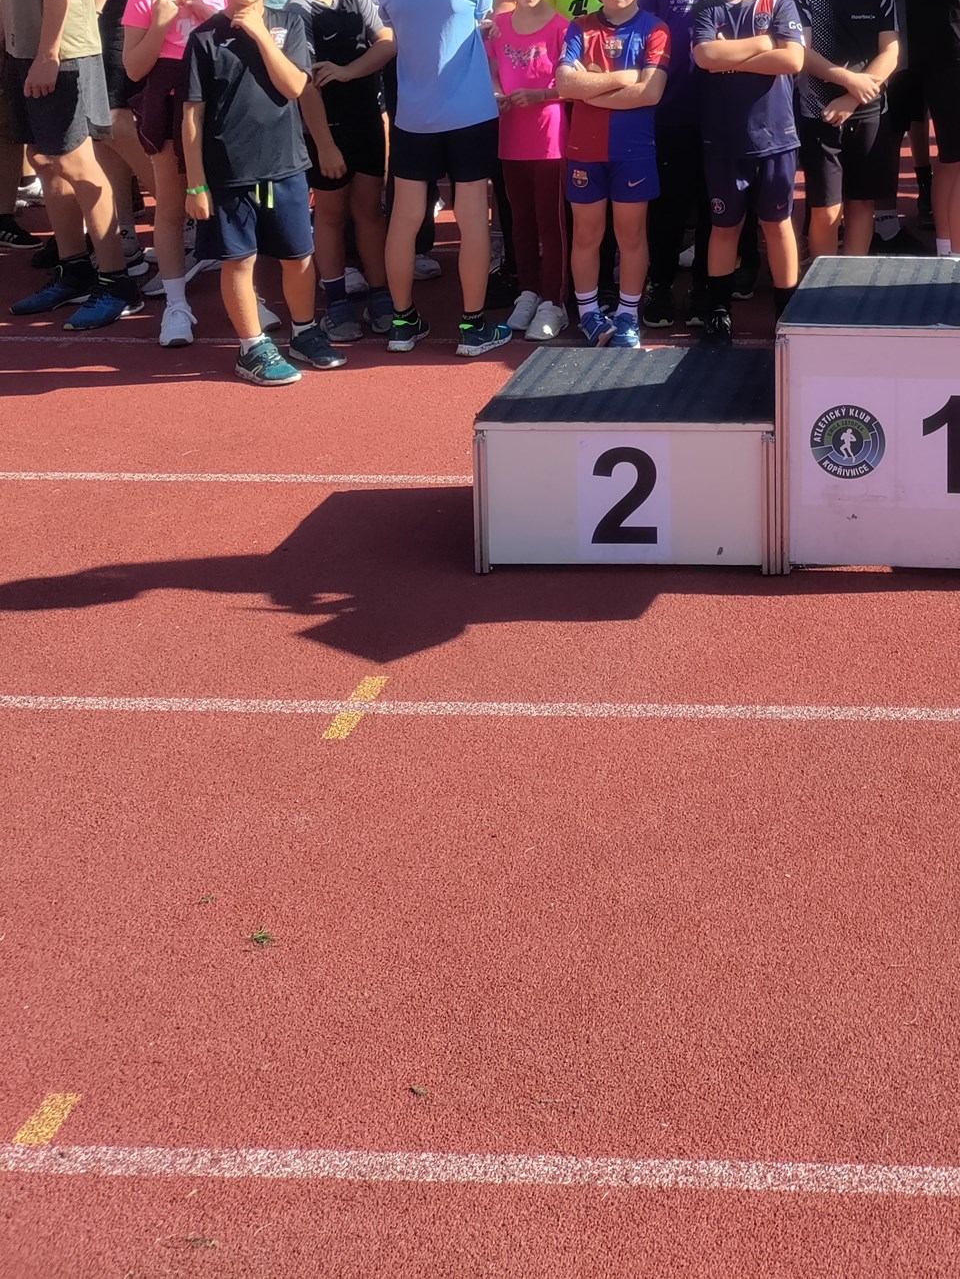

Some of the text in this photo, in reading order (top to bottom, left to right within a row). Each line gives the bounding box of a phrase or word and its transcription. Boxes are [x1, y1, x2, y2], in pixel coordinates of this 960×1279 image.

[813, 406, 871, 443] ATLETICKÝ KLUB
[822, 459, 870, 477] KOPŘIVNICE
[592, 447, 658, 545] 2
